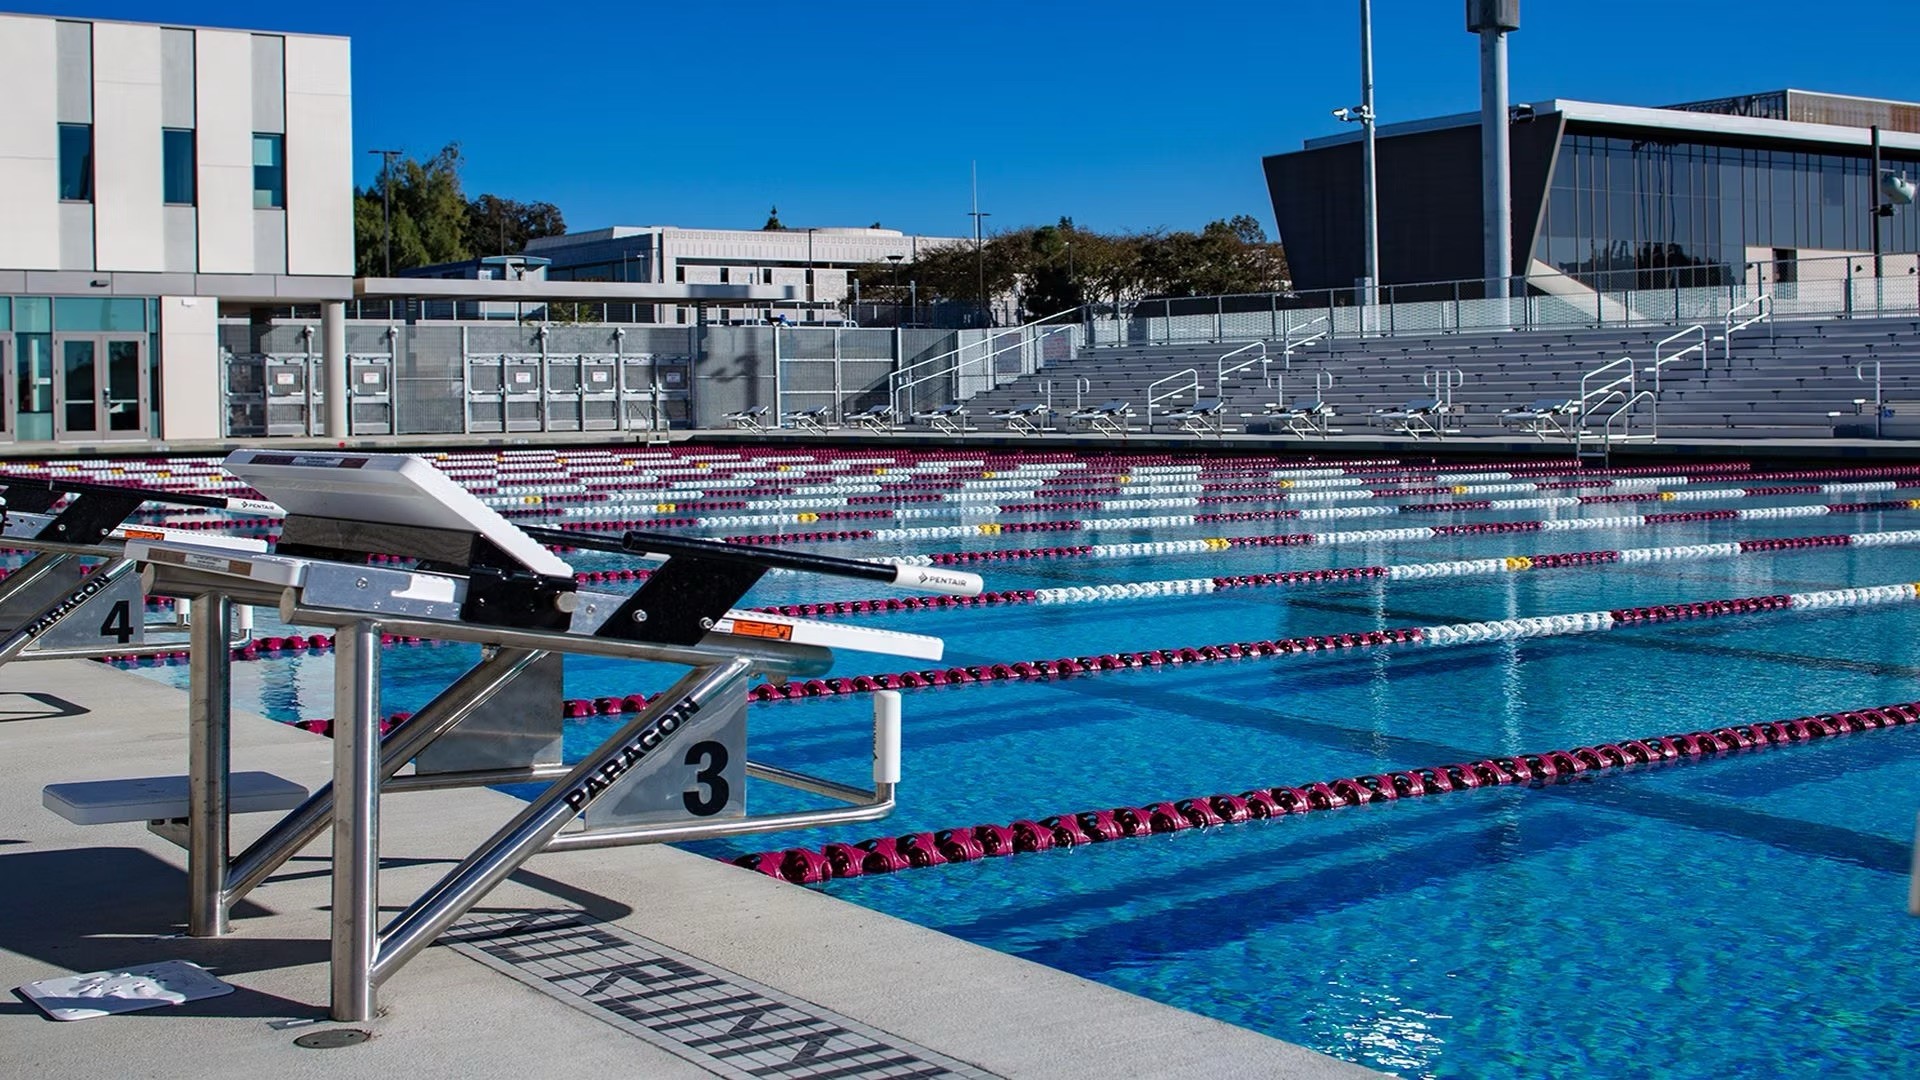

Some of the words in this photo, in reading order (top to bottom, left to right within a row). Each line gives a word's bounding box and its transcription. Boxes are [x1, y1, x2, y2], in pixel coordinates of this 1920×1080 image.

[24, 573, 112, 638] PARAGON
[929, 576, 967, 587] PENTAIR
[101, 600, 134, 644] 4
[563, 695, 700, 813] PARAGON
[683, 740, 730, 817] 3
